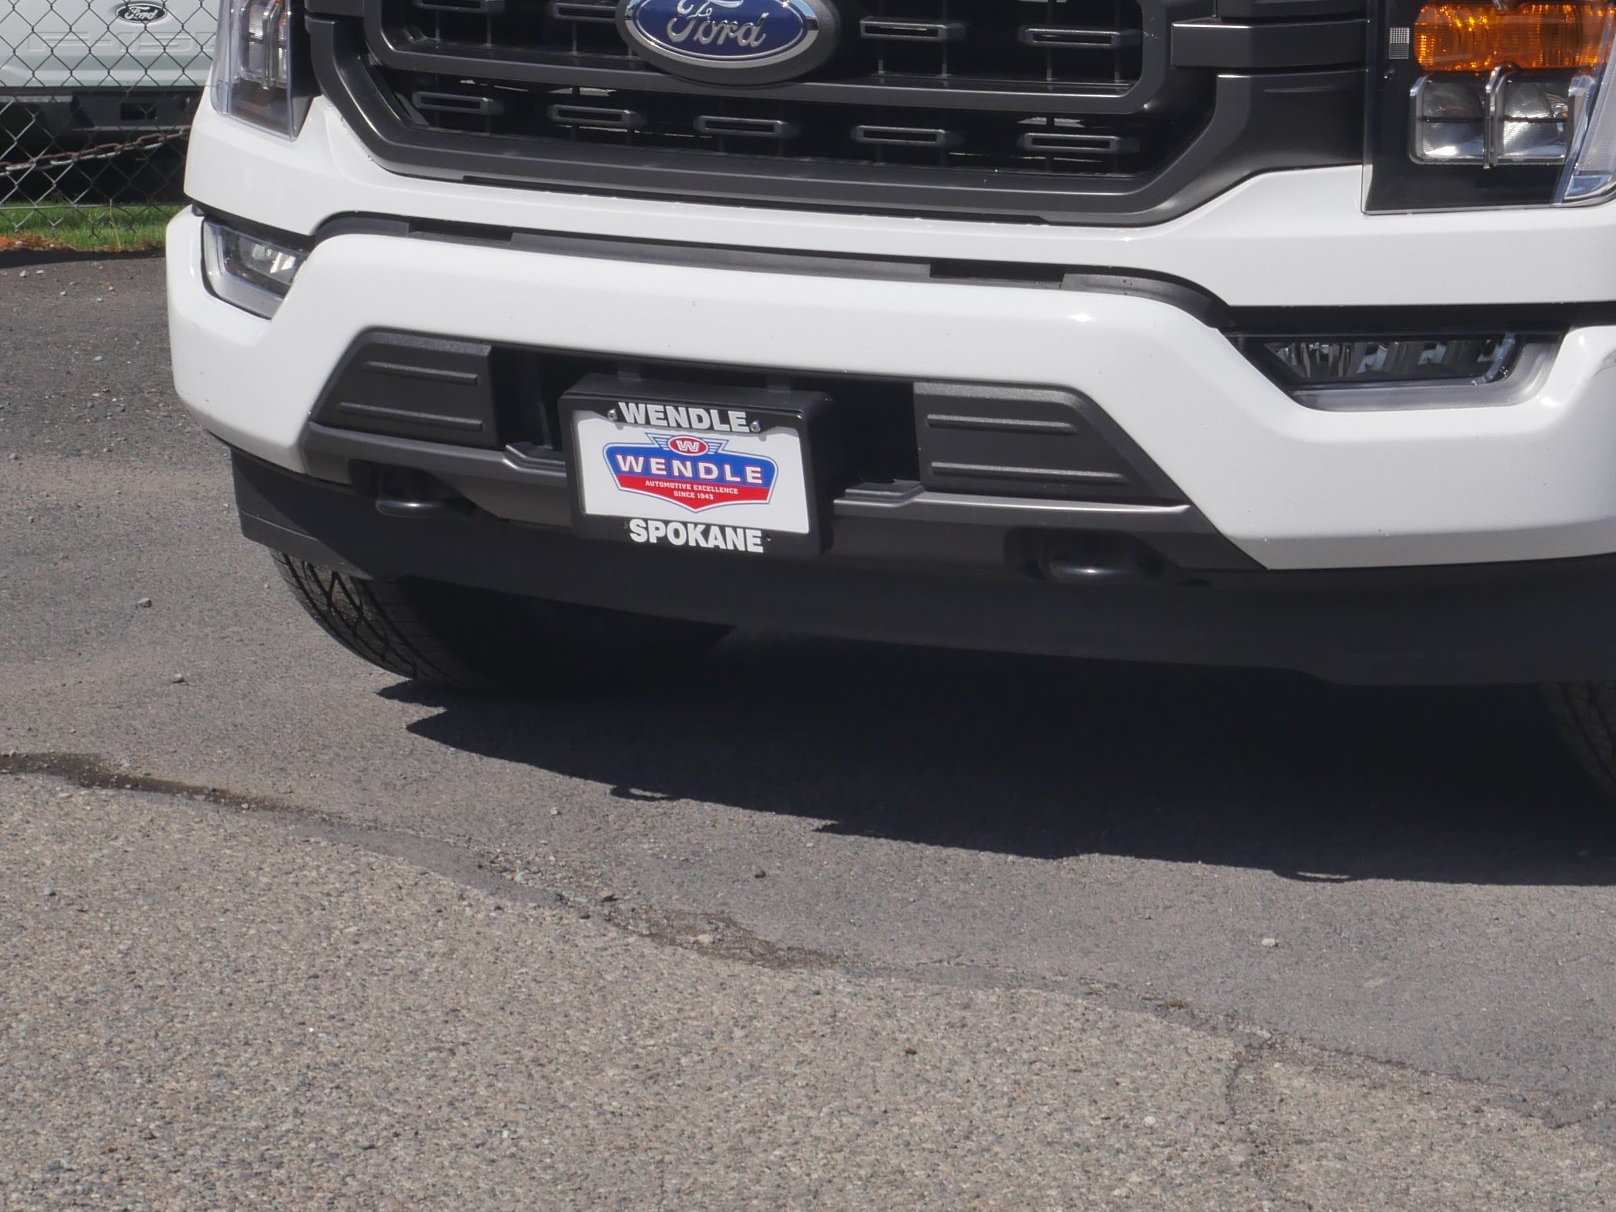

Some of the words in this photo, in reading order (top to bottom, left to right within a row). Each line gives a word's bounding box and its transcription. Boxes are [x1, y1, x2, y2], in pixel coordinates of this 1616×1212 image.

[124, 6, 158, 20] Ford
[618, 401, 751, 433] WENDLE
[675, 440, 700, 453] W
[616, 454, 763, 484] WENDLE
[645, 480, 691, 491] AUTOMOTIVE
[693, 484, 739, 495] EXCELLENCE
[673, 490, 696, 499] SINCE
[629, 518, 764, 553] SPOKANE
